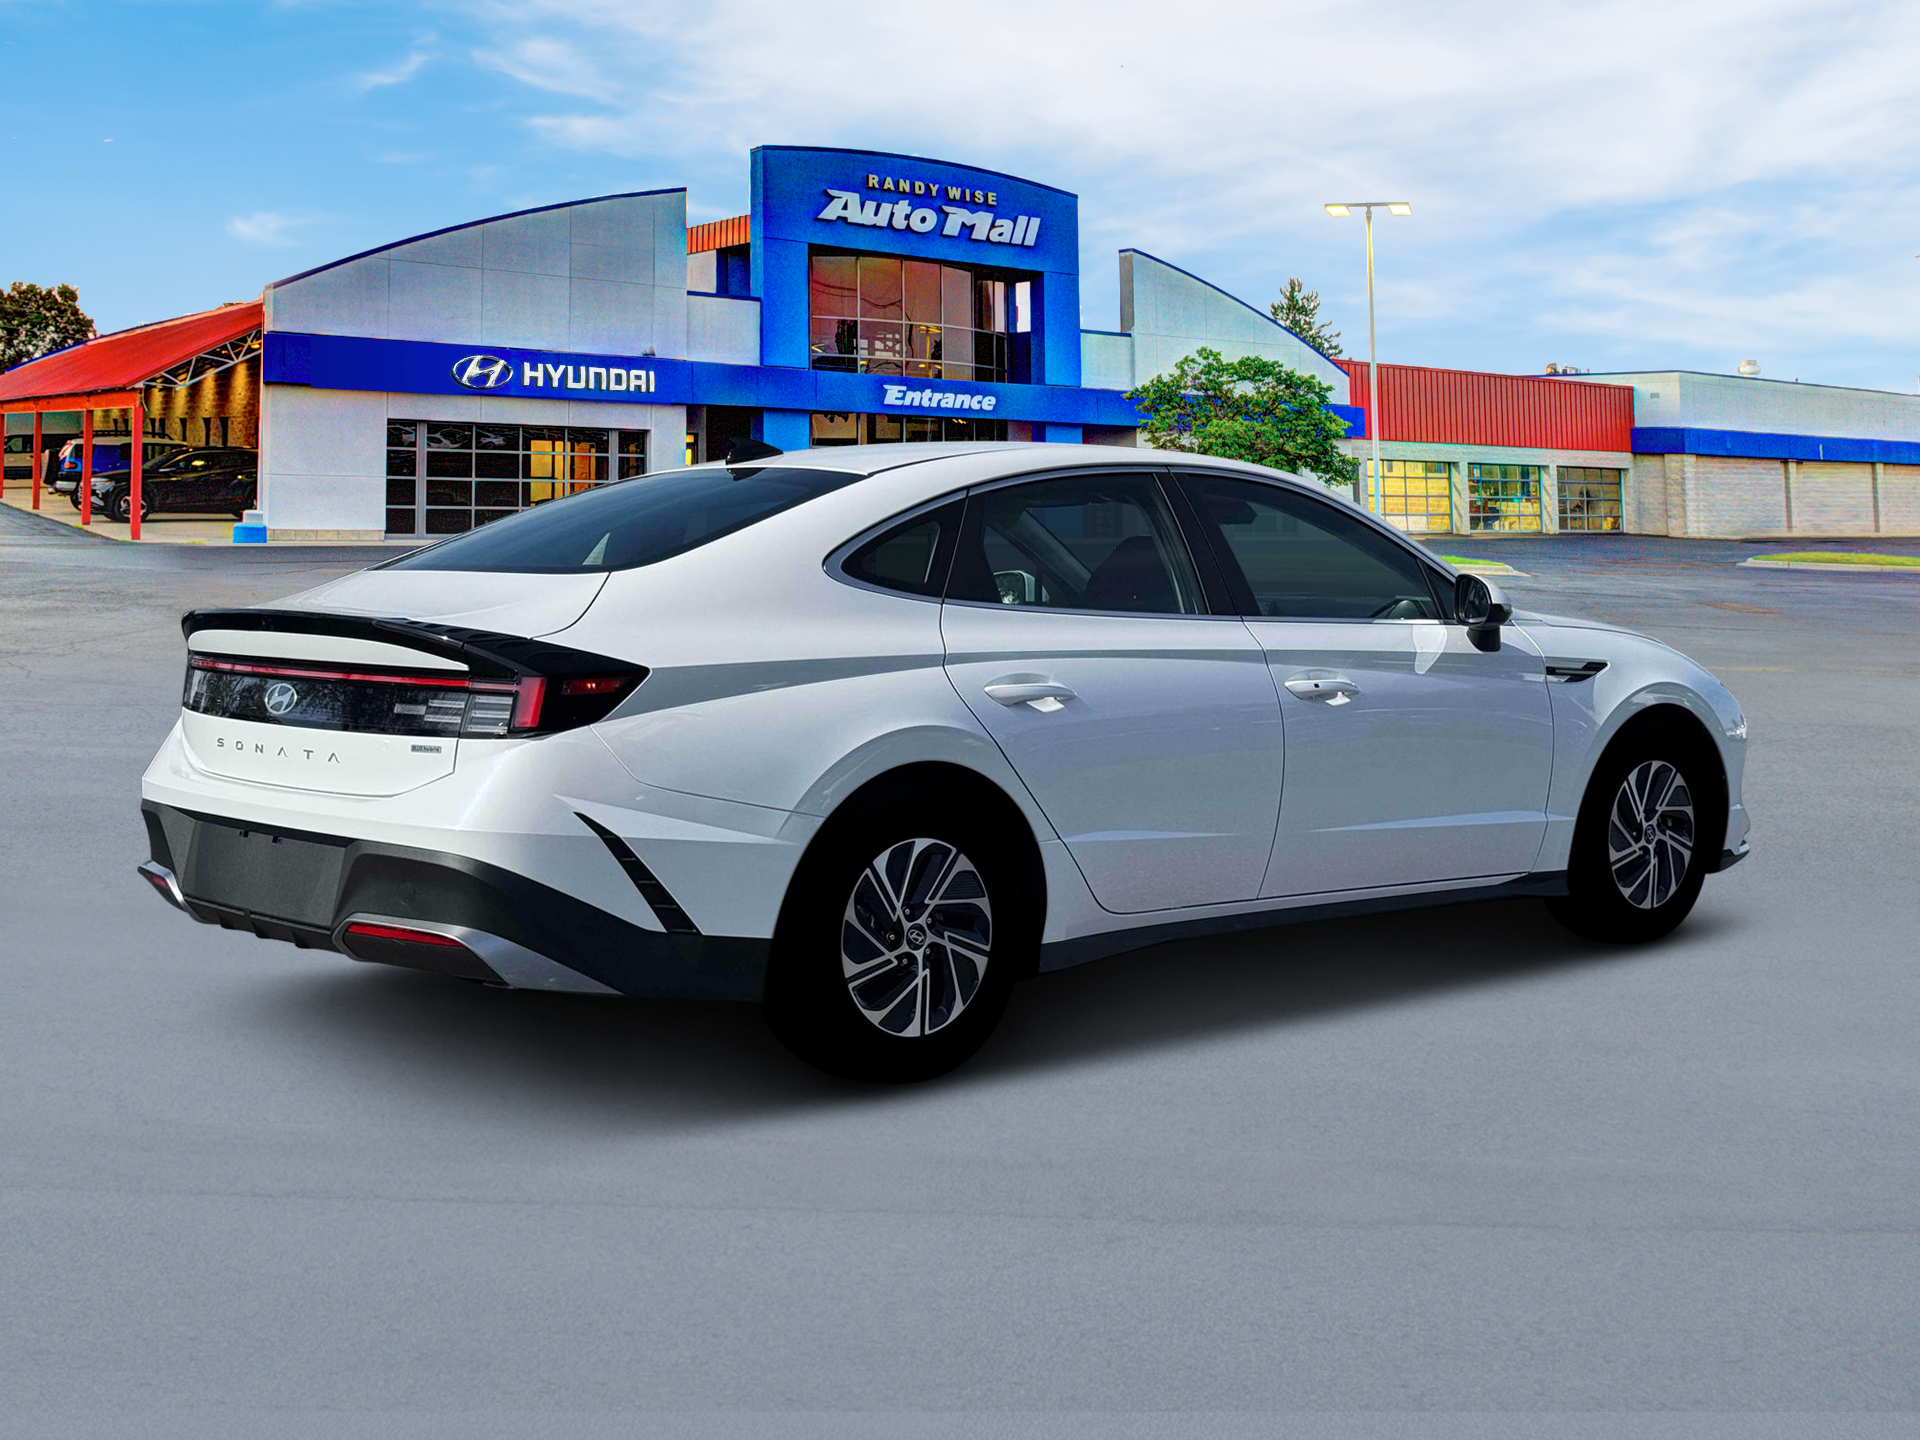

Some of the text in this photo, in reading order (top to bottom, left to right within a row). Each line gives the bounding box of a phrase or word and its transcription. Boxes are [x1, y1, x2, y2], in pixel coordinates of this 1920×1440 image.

[866, 174, 997, 205] RANDY WISE
[816, 189, 1041, 246] Auto Mall
[522, 362, 655, 393] HYUNDAI
[883, 384, 996, 411] Entrance
[217, 737, 341, 764] SONATA
